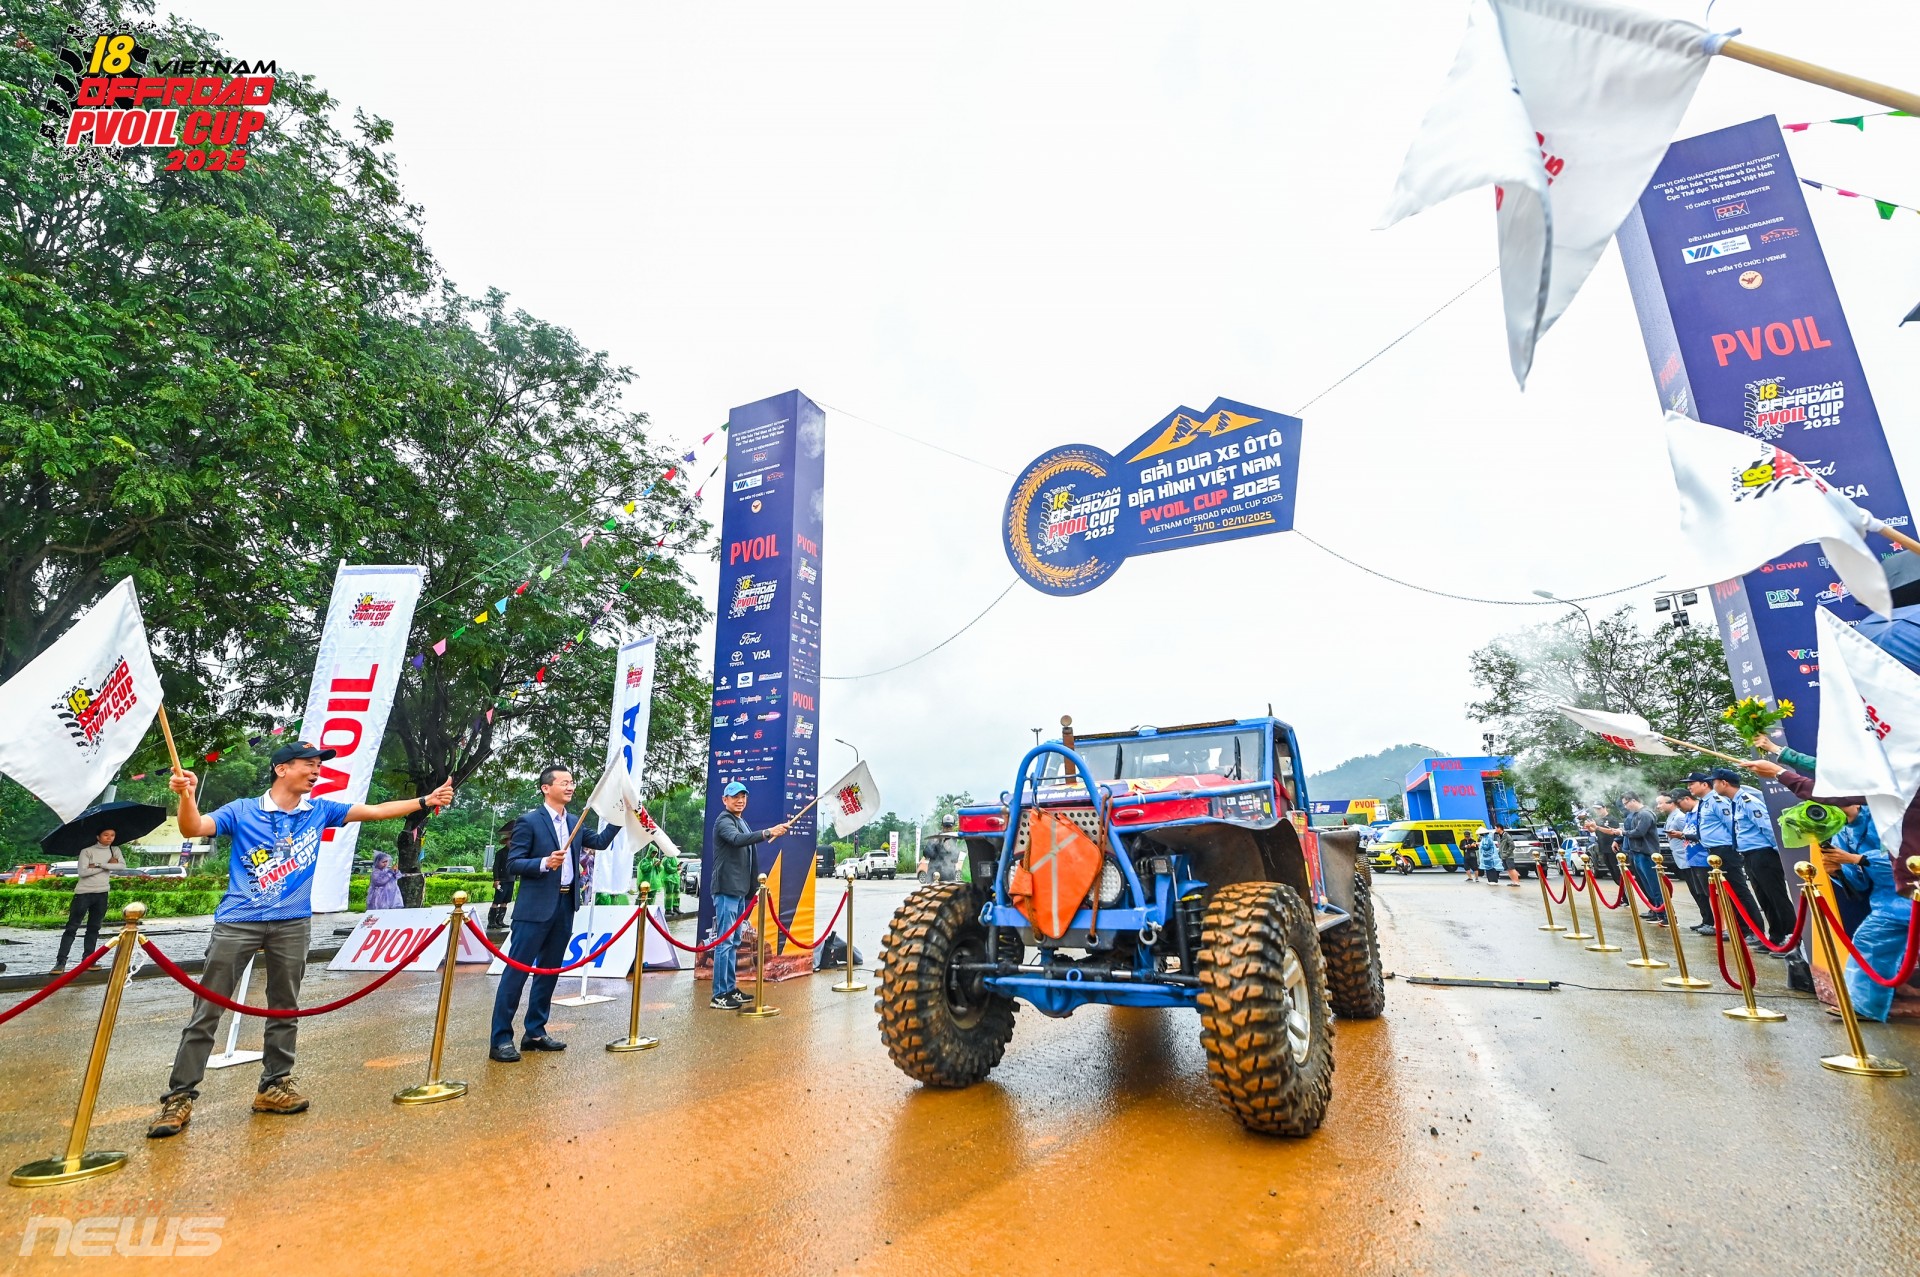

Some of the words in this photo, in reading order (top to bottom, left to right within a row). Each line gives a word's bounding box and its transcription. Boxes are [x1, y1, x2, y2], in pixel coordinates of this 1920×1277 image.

[1746, 152, 1780, 166] AUTHORITY
[1719, 172, 1734, 180] thao
[1757, 162, 1772, 171] Lịch
[1725, 178, 1740, 187] thao
[1758, 170, 1775, 178] Nam
[1766, 253, 1787, 262] VENUE
[1711, 316, 1832, 367] PVOIL
[1760, 384, 1778, 400] 18
[1786, 380, 1844, 396] VIETNAM
[1758, 387, 1844, 412] OFFROAD
[1756, 406, 1808, 428] PVOIL
[1808, 400, 1844, 418] CUP
[1803, 416, 1841, 430] 2025
[1140, 459, 1173, 484] GIẢI
[1176, 452, 1212, 474] ĐUA
[1214, 443, 1241, 463] XE
[1244, 429, 1283, 454] ÔTÔ
[1128, 488, 1155, 508] ĐỊA
[1157, 476, 1196, 500] HÌNH
[1199, 465, 1238, 487] VIỆT
[1241, 452, 1282, 476] NAM
[1053, 491, 1070, 510] 18
[1075, 486, 1121, 504] VIETNAM
[1140, 501, 1190, 525] PVOIL
[1193, 489, 1228, 511] CUP
[1232, 474, 1281, 501] 2025
[1050, 493, 1121, 524] OFFROAD
[1148, 519, 1182, 534] VIETNAM
[1184, 510, 1219, 526] OFFROAD
[1221, 504, 1244, 516] PVOIL
[1244, 499, 1261, 512] CUP
[1262, 493, 1284, 506] 2025
[1048, 515, 1088, 540] PVOIL
[1090, 508, 1120, 528] CUP
[1193, 518, 1215, 532] 31/10
[1222, 511, 1272, 528] 02/11/2025
[1084, 524, 1115, 541] 2025
[730, 534, 779, 566] PVOIL
[797, 534, 818, 558] PVOIL
[1776, 560, 1808, 571] GWM
[738, 584, 777, 598] OFFROAD
[742, 580, 750, 590] 18
[752, 580, 778, 588] VIETNAM
[736, 595, 758, 608] PVOIL
[758, 593, 774, 604] CUP
[1766, 588, 1800, 603] DBV
[353, 612, 375, 620] PVOIL
[375, 612, 390, 620] CUP
[754, 604, 770, 612] 2025
[740, 632, 762, 646] Ford
[752, 650, 770, 660] VISA
[95, 654, 125, 694] VIETNAM
[67, 688, 91, 715] 18
[77, 660, 130, 728] OFFROAD
[792, 692, 814, 712] PVOIL
[84, 702, 113, 742] PVOIL
[111, 675, 134, 709] CUP
[113, 693, 137, 722] 2025
[1432, 760, 1464, 770] PVOIL
[1443, 785, 1477, 796] PVOIL
[251, 849, 270, 867] 18
[258, 858, 300, 889] PVOIL
